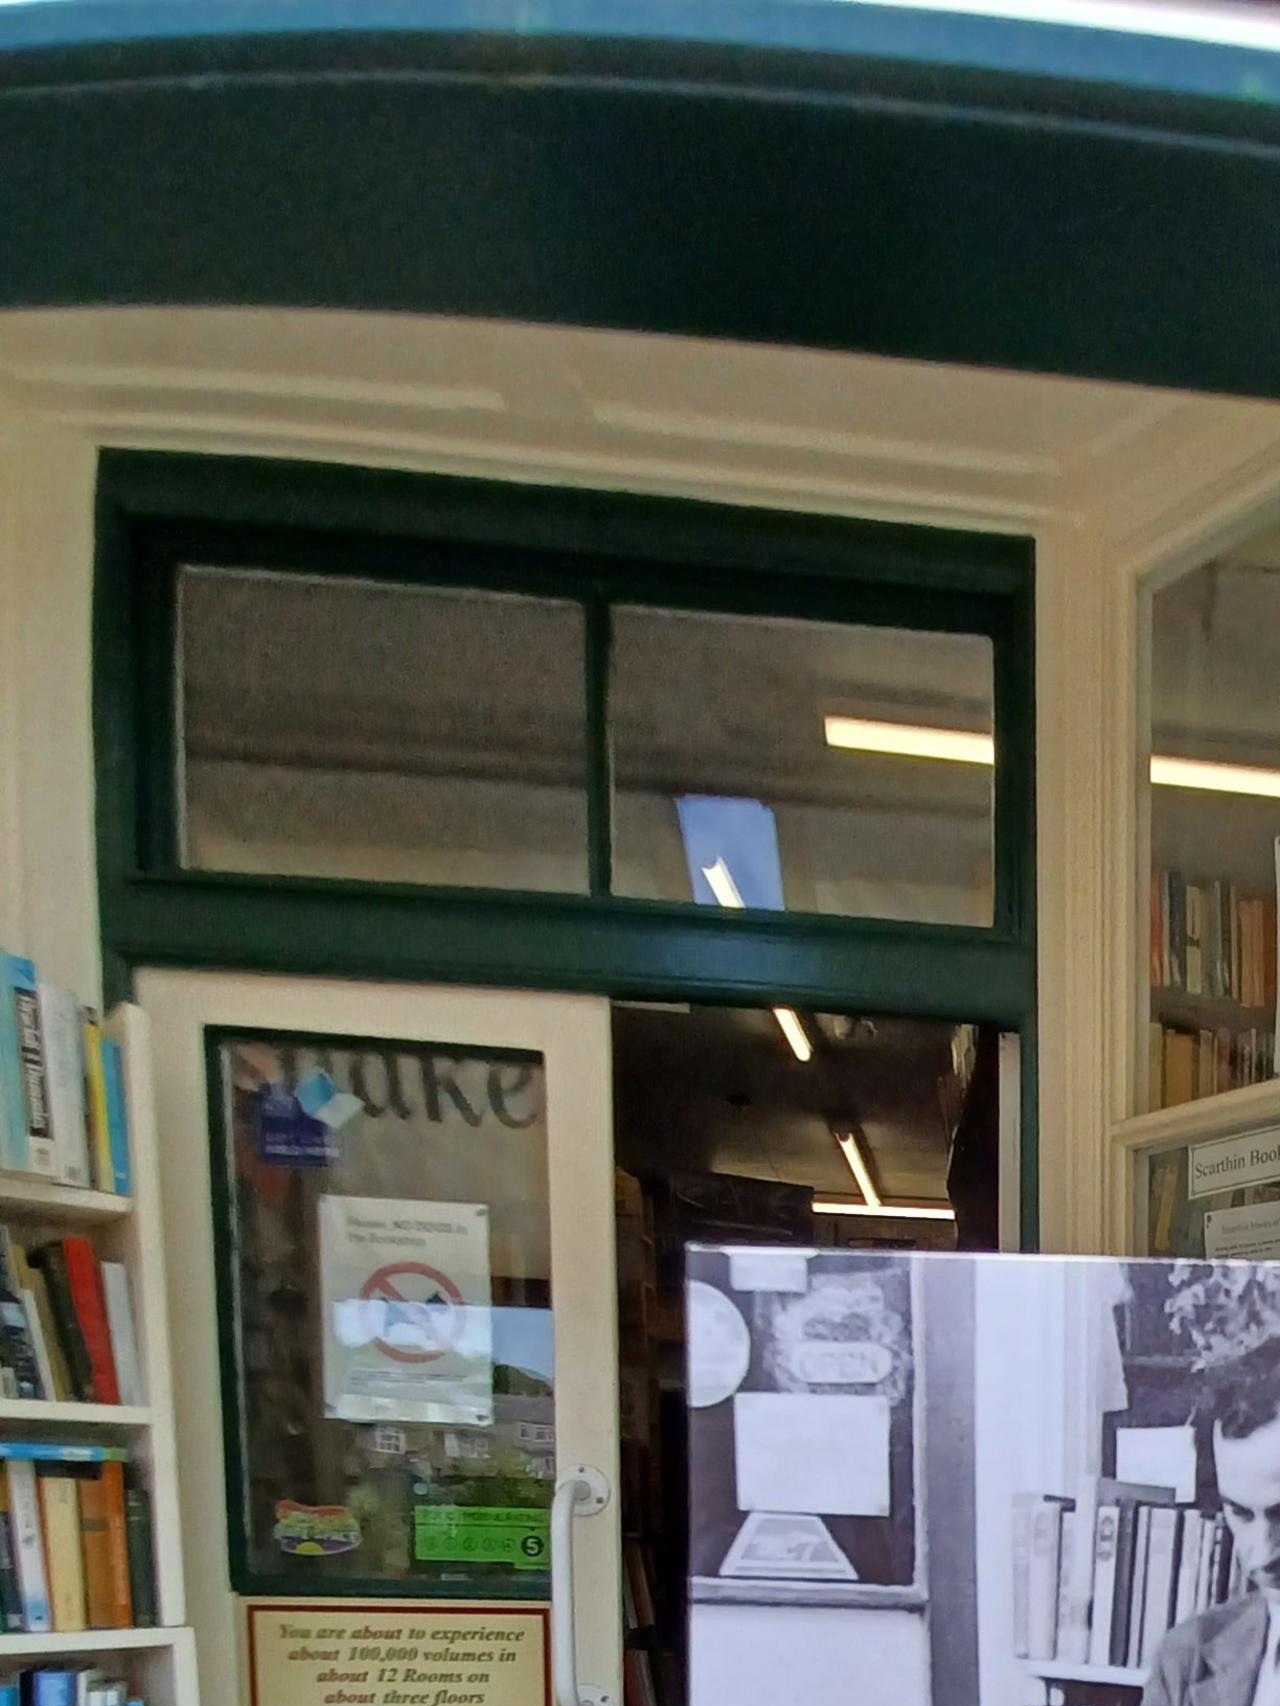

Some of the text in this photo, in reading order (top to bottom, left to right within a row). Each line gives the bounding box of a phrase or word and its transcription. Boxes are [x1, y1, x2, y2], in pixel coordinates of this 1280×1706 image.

[1195, 1155, 1246, 1179] Scarthin
[527, 1538, 539, 1554] 5
[279, 1624, 525, 1645] You are about to experience
[287, 1646, 517, 1663] about 100,000 volumes in
[316, 1668, 490, 1684] about 12 Rooms on
[324, 1690, 376, 1704] about
[382, 1690, 429, 1705] three
